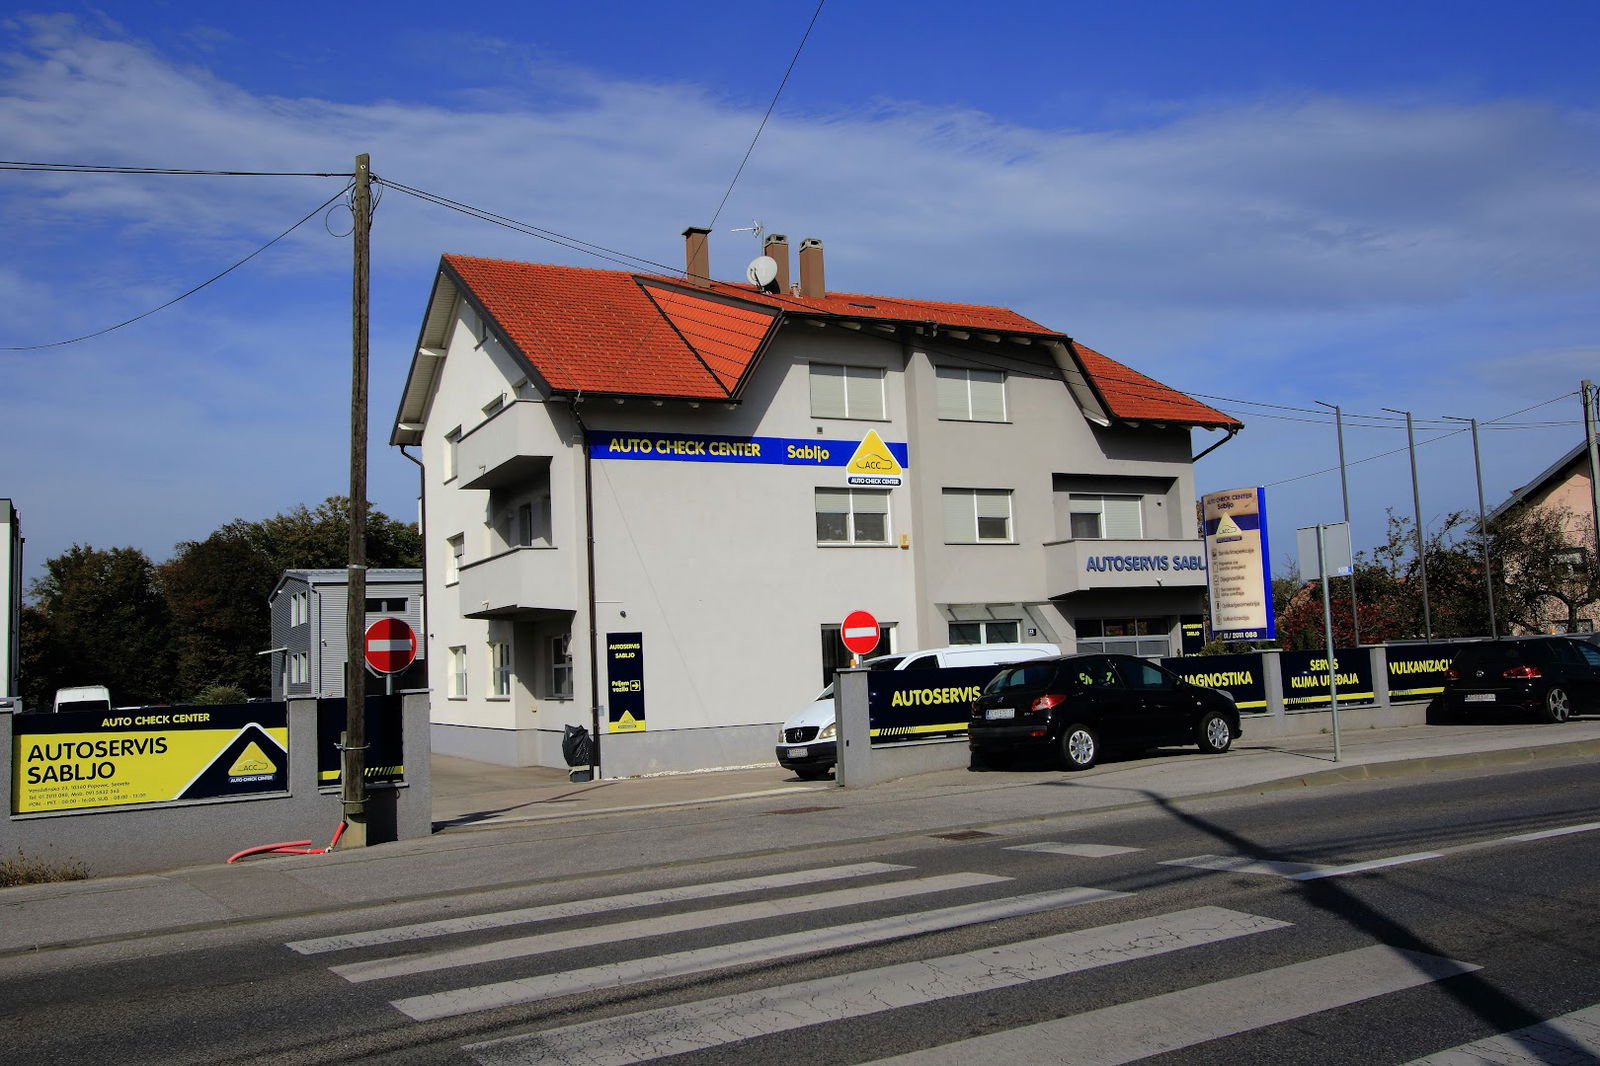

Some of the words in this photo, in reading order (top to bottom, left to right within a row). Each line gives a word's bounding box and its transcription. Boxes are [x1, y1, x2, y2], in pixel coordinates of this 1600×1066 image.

[608, 437, 653, 453] AUTO
[655, 439, 705, 456] CHECK
[708, 441, 761, 457] CENTER
[786, 444, 830, 463] Sabljo
[864, 461, 881, 470] ACC
[1086, 555, 1169, 572] AUTOSERVIS
[1172, 555, 1207, 571] SABL
[1310, 657, 1339, 671] SERVS
[1389, 658, 1453, 675] VULKANIZACI
[1184, 670, 1253, 688] IAGNOSTIKA
[1291, 675, 1319, 689] KLIMA
[891, 685, 981, 707] AUTOSERVIS
[101, 716, 132, 728] AUTO
[134, 715, 170, 726] CHECK
[172, 712, 210, 724] CENTER
[27, 736, 168, 763] AUTOSERVIS
[27, 761, 116, 785] SABLJO
